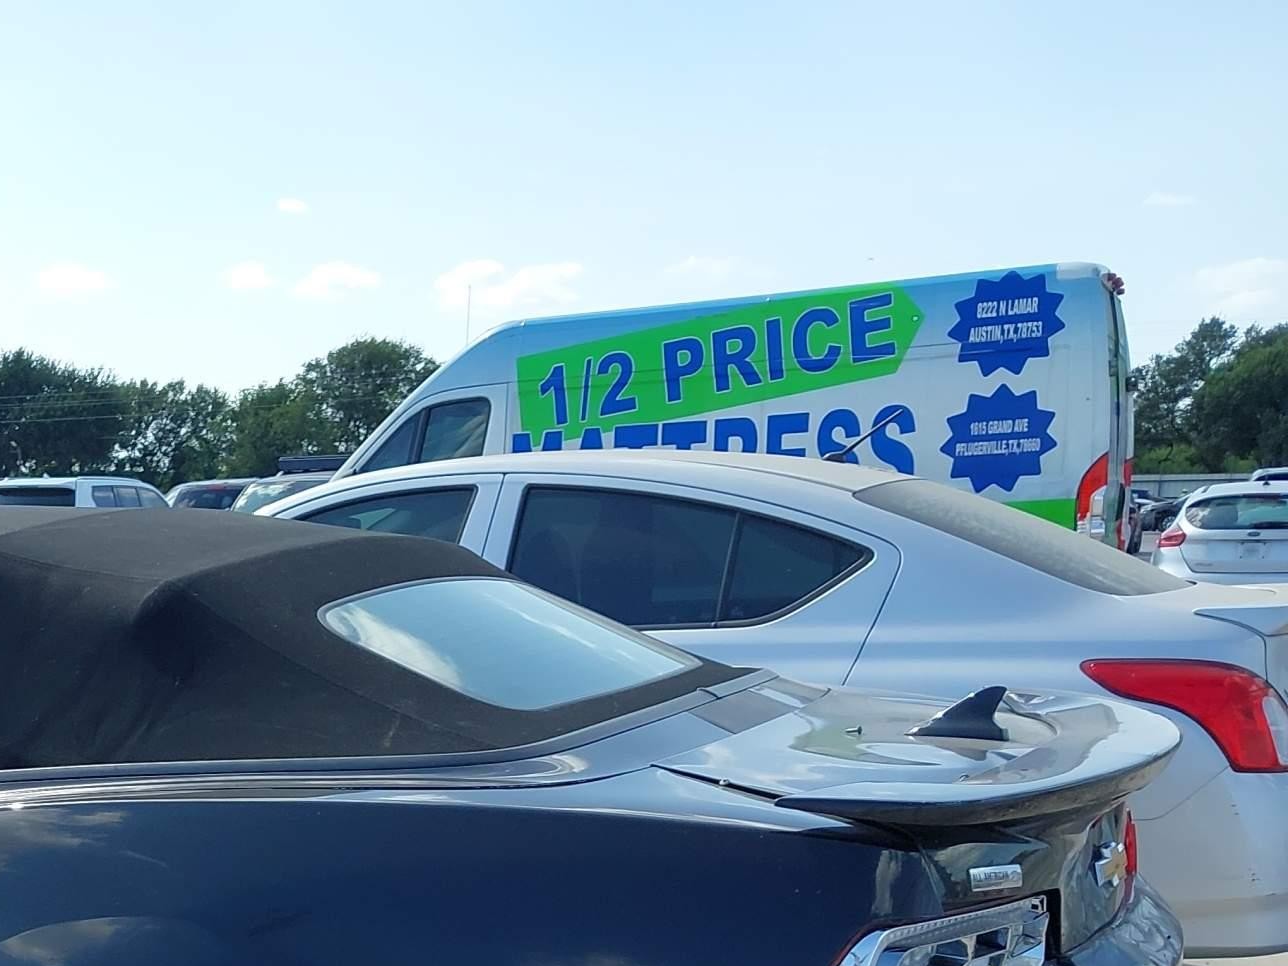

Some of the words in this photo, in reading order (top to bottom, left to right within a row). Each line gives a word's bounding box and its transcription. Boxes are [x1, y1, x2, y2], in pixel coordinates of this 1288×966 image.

[976, 301, 998, 319] 8222
[999, 299, 1007, 316] N
[1007, 297, 1039, 315] LAMAR
[539, 350, 638, 426] 1/2
[662, 292, 896, 403] PRICE
[987, 419, 1013, 434] GRAND
[1013, 418, 1029, 433] AVE
